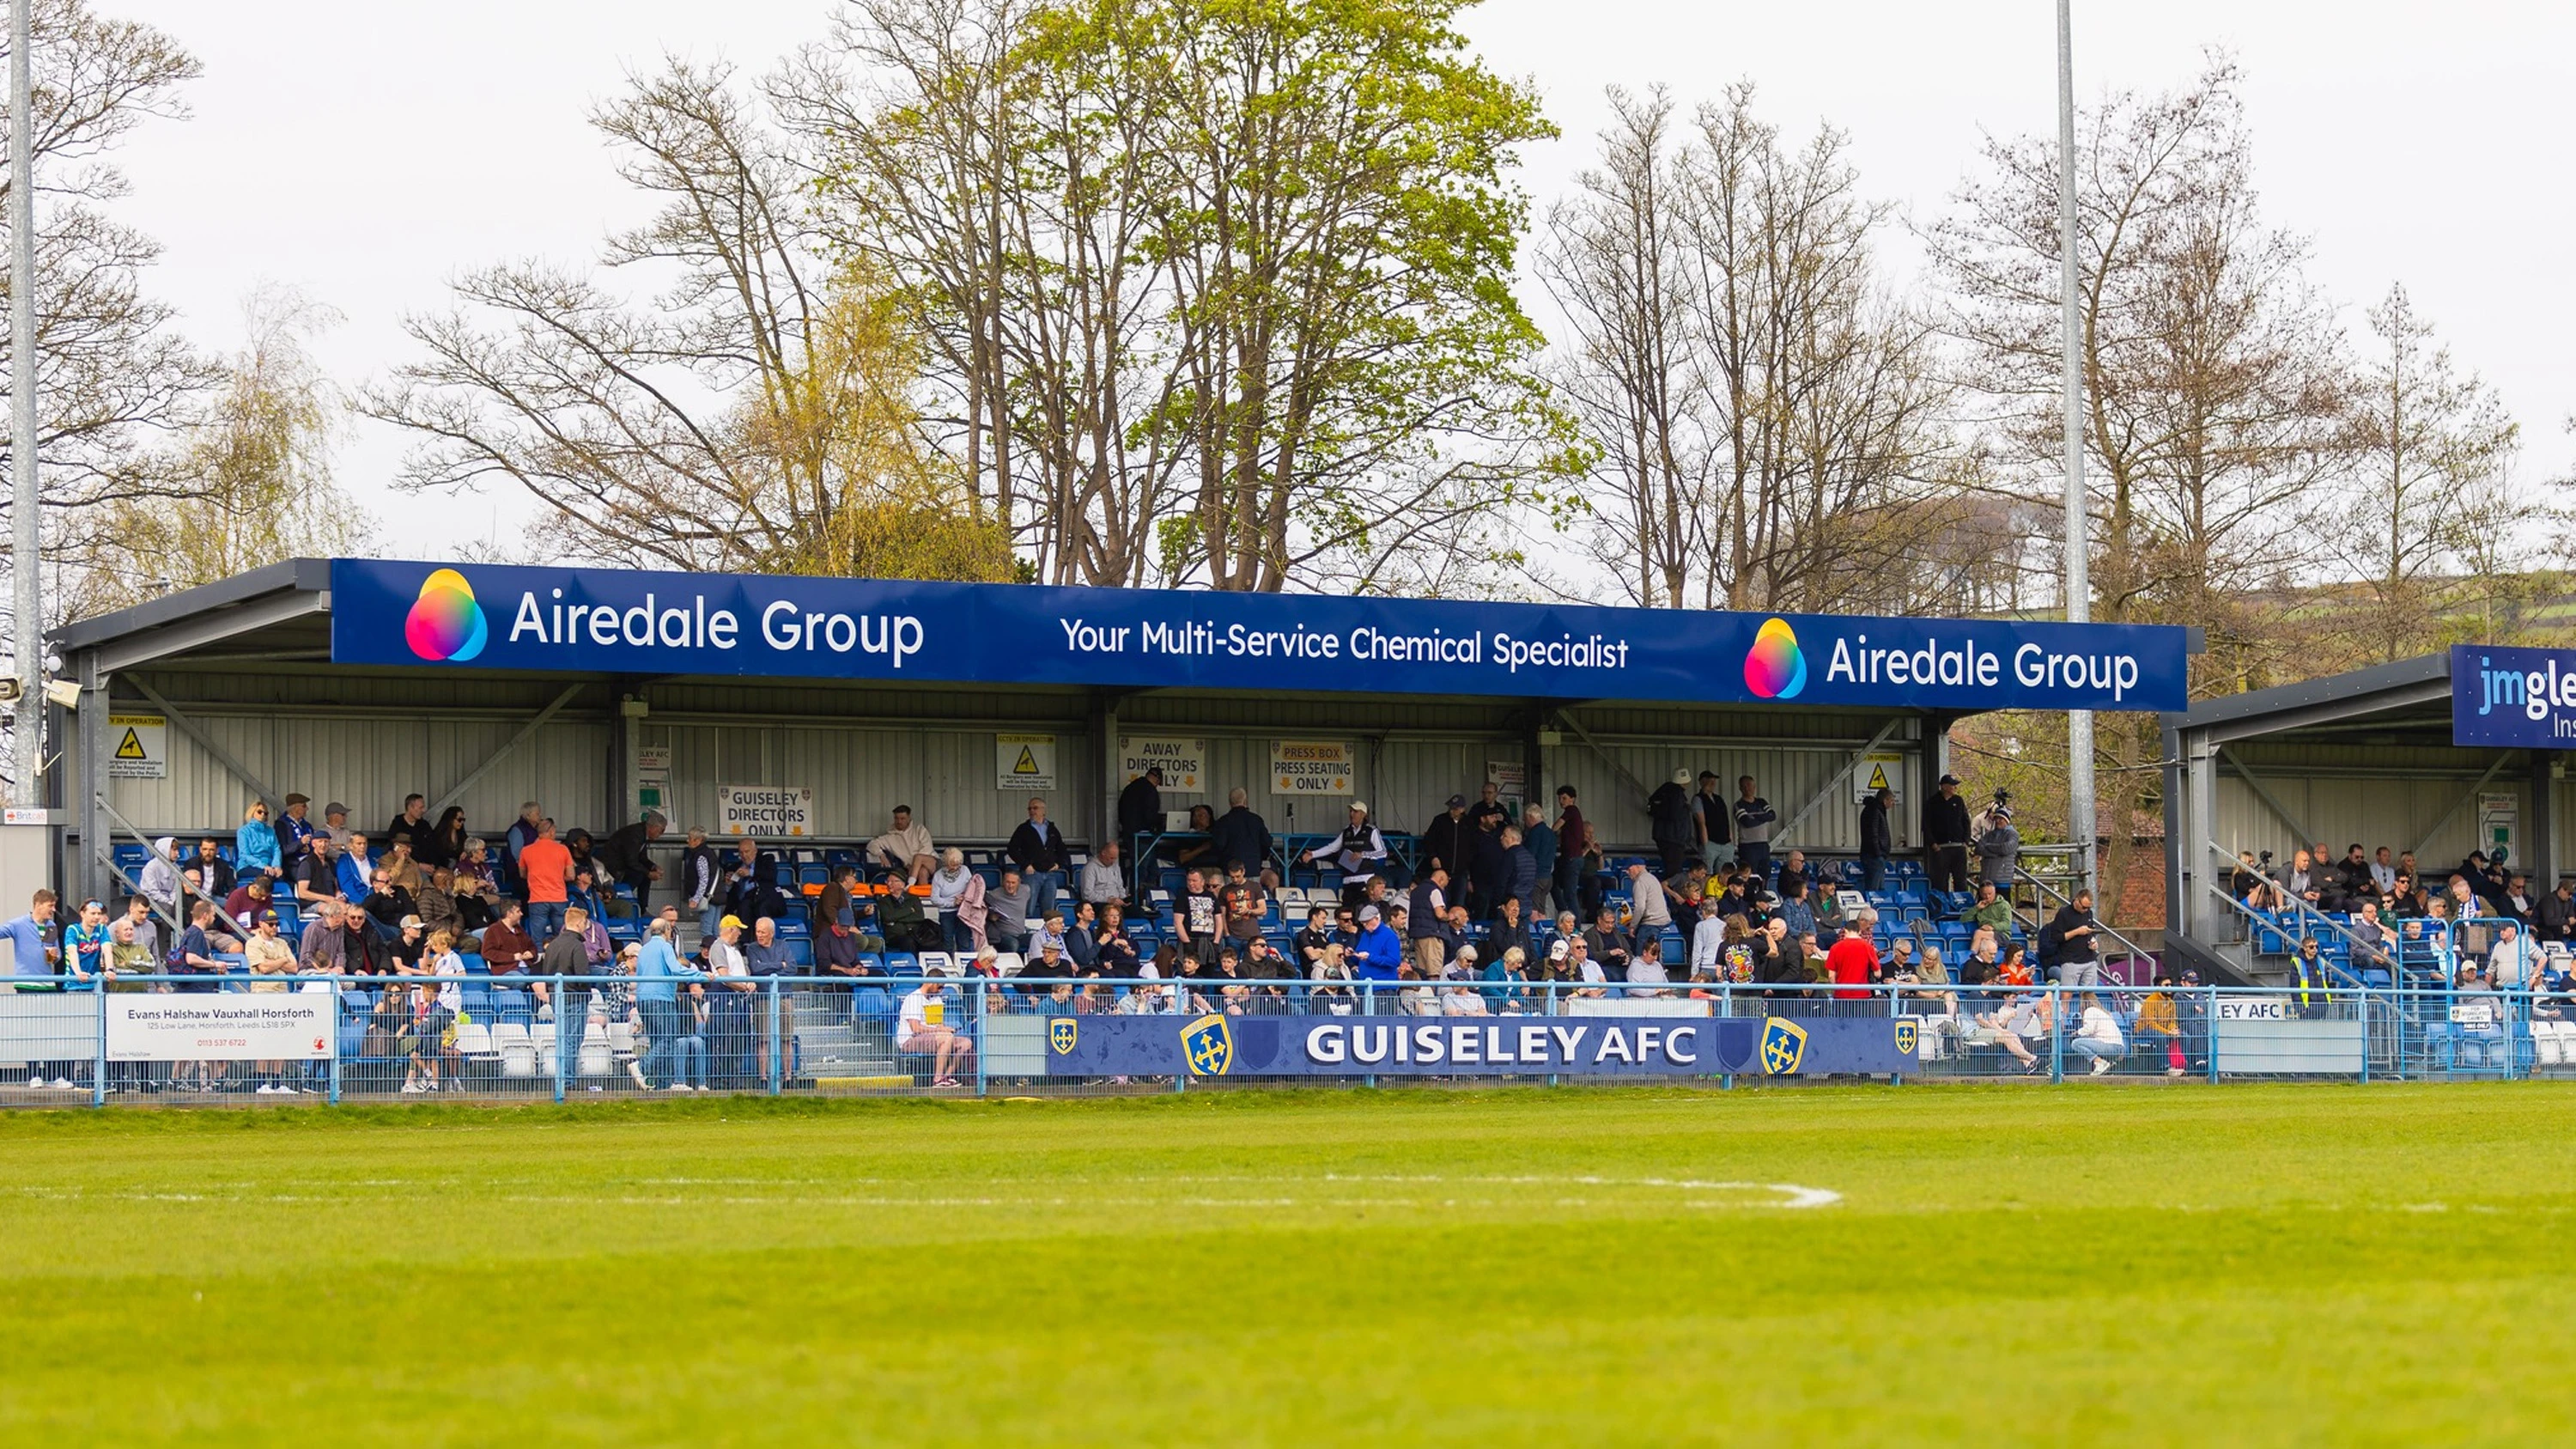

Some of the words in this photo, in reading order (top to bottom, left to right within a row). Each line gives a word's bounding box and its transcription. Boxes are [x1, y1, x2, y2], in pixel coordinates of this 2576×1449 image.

[510, 588, 738, 650] Airedale
[762, 600, 925, 669] Group
[1060, 618, 1132, 653] Your
[1142, 620, 1340, 659] Multi-Service
[1350, 626, 1482, 664] Chemical
[1492, 632, 1630, 674] Specialist
[1826, 634, 2001, 687] Airedale
[2014, 642, 2139, 703] Group
[1143, 743, 1182, 756] AWAY
[1285, 747, 1315, 758] PRESS
[1319, 748, 1340, 758] BOX
[1127, 758, 1198, 772] DIRECTORS
[1274, 761, 1305, 774] PRESS
[1308, 762, 1351, 776] SEATING
[1296, 776, 1330, 790] ONLY
[732, 791, 799, 806] GUISELEY
[727, 807, 805, 822] DIRECTORS
[748, 825, 786, 836] ONLY
[128, 1008, 161, 1020] Evans
[163, 1008, 210, 1020] Halshaw
[212, 1008, 259, 1020] Vauxhall
[261, 1008, 315, 1019] Horsforth
[2217, 1003, 2243, 1020] EY
[2248, 1003, 2280, 1019] AFC
[261, 1020, 279, 1029] LS18
[197, 1038, 213, 1047] 0113
[214, 1038, 228, 1047] 537
[228, 1038, 247, 1047] 6722
[1305, 1023, 1589, 1063] GUISELEY
[1595, 1026, 1698, 1063] AFC
